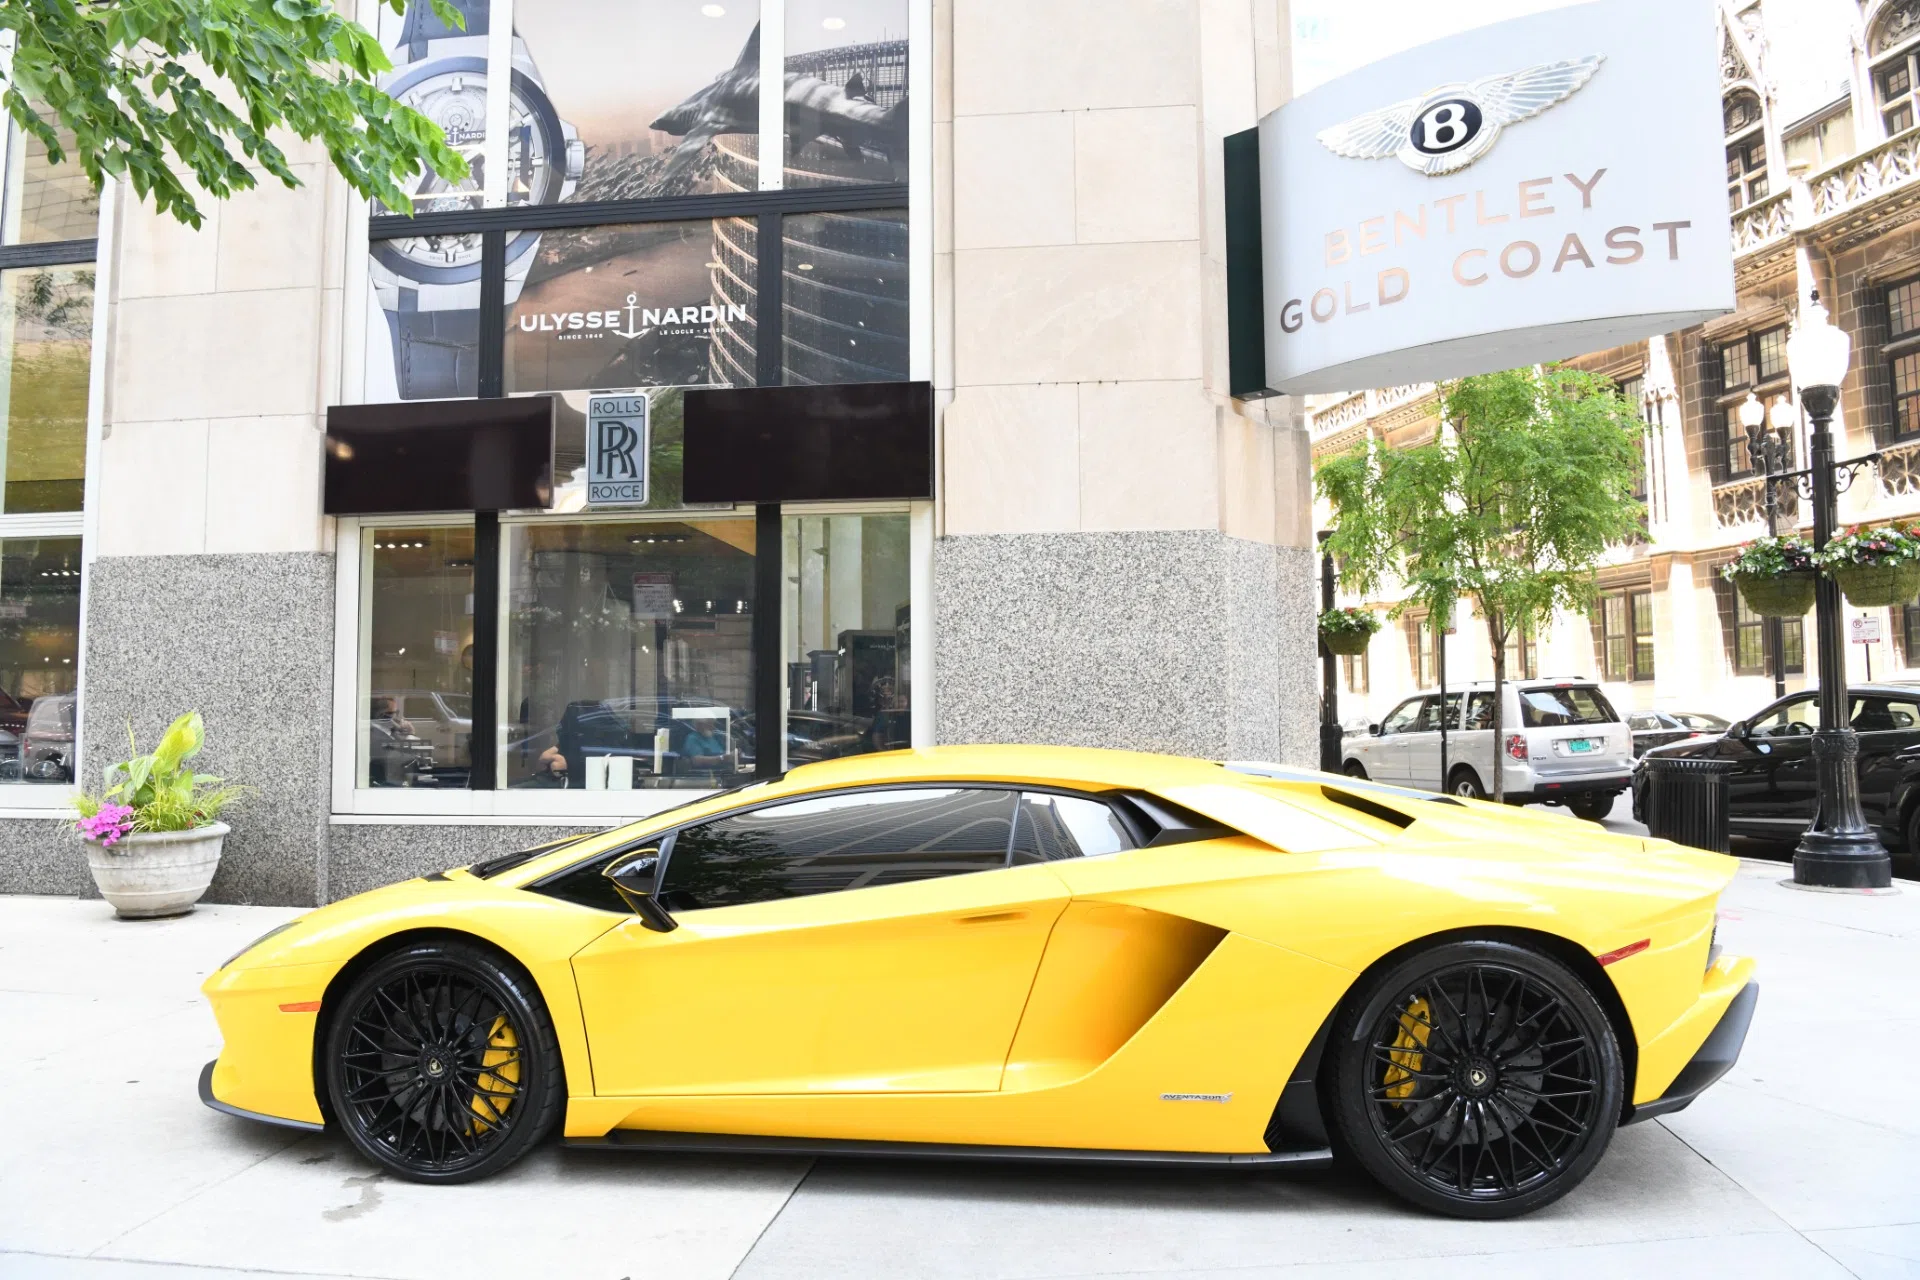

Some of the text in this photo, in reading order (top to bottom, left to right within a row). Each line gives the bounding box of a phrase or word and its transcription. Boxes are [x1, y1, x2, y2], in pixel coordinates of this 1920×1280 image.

[459, 131, 485, 140] NARDI
[1421, 103, 1469, 149] B
[1325, 168, 1608, 268] BENTLEY
[1280, 220, 1692, 334] GOLD COAST
[520, 304, 747, 332] ULYSSE NARDIN
[593, 400, 641, 414] ROLLS
[591, 485, 640, 499] ROYCE
